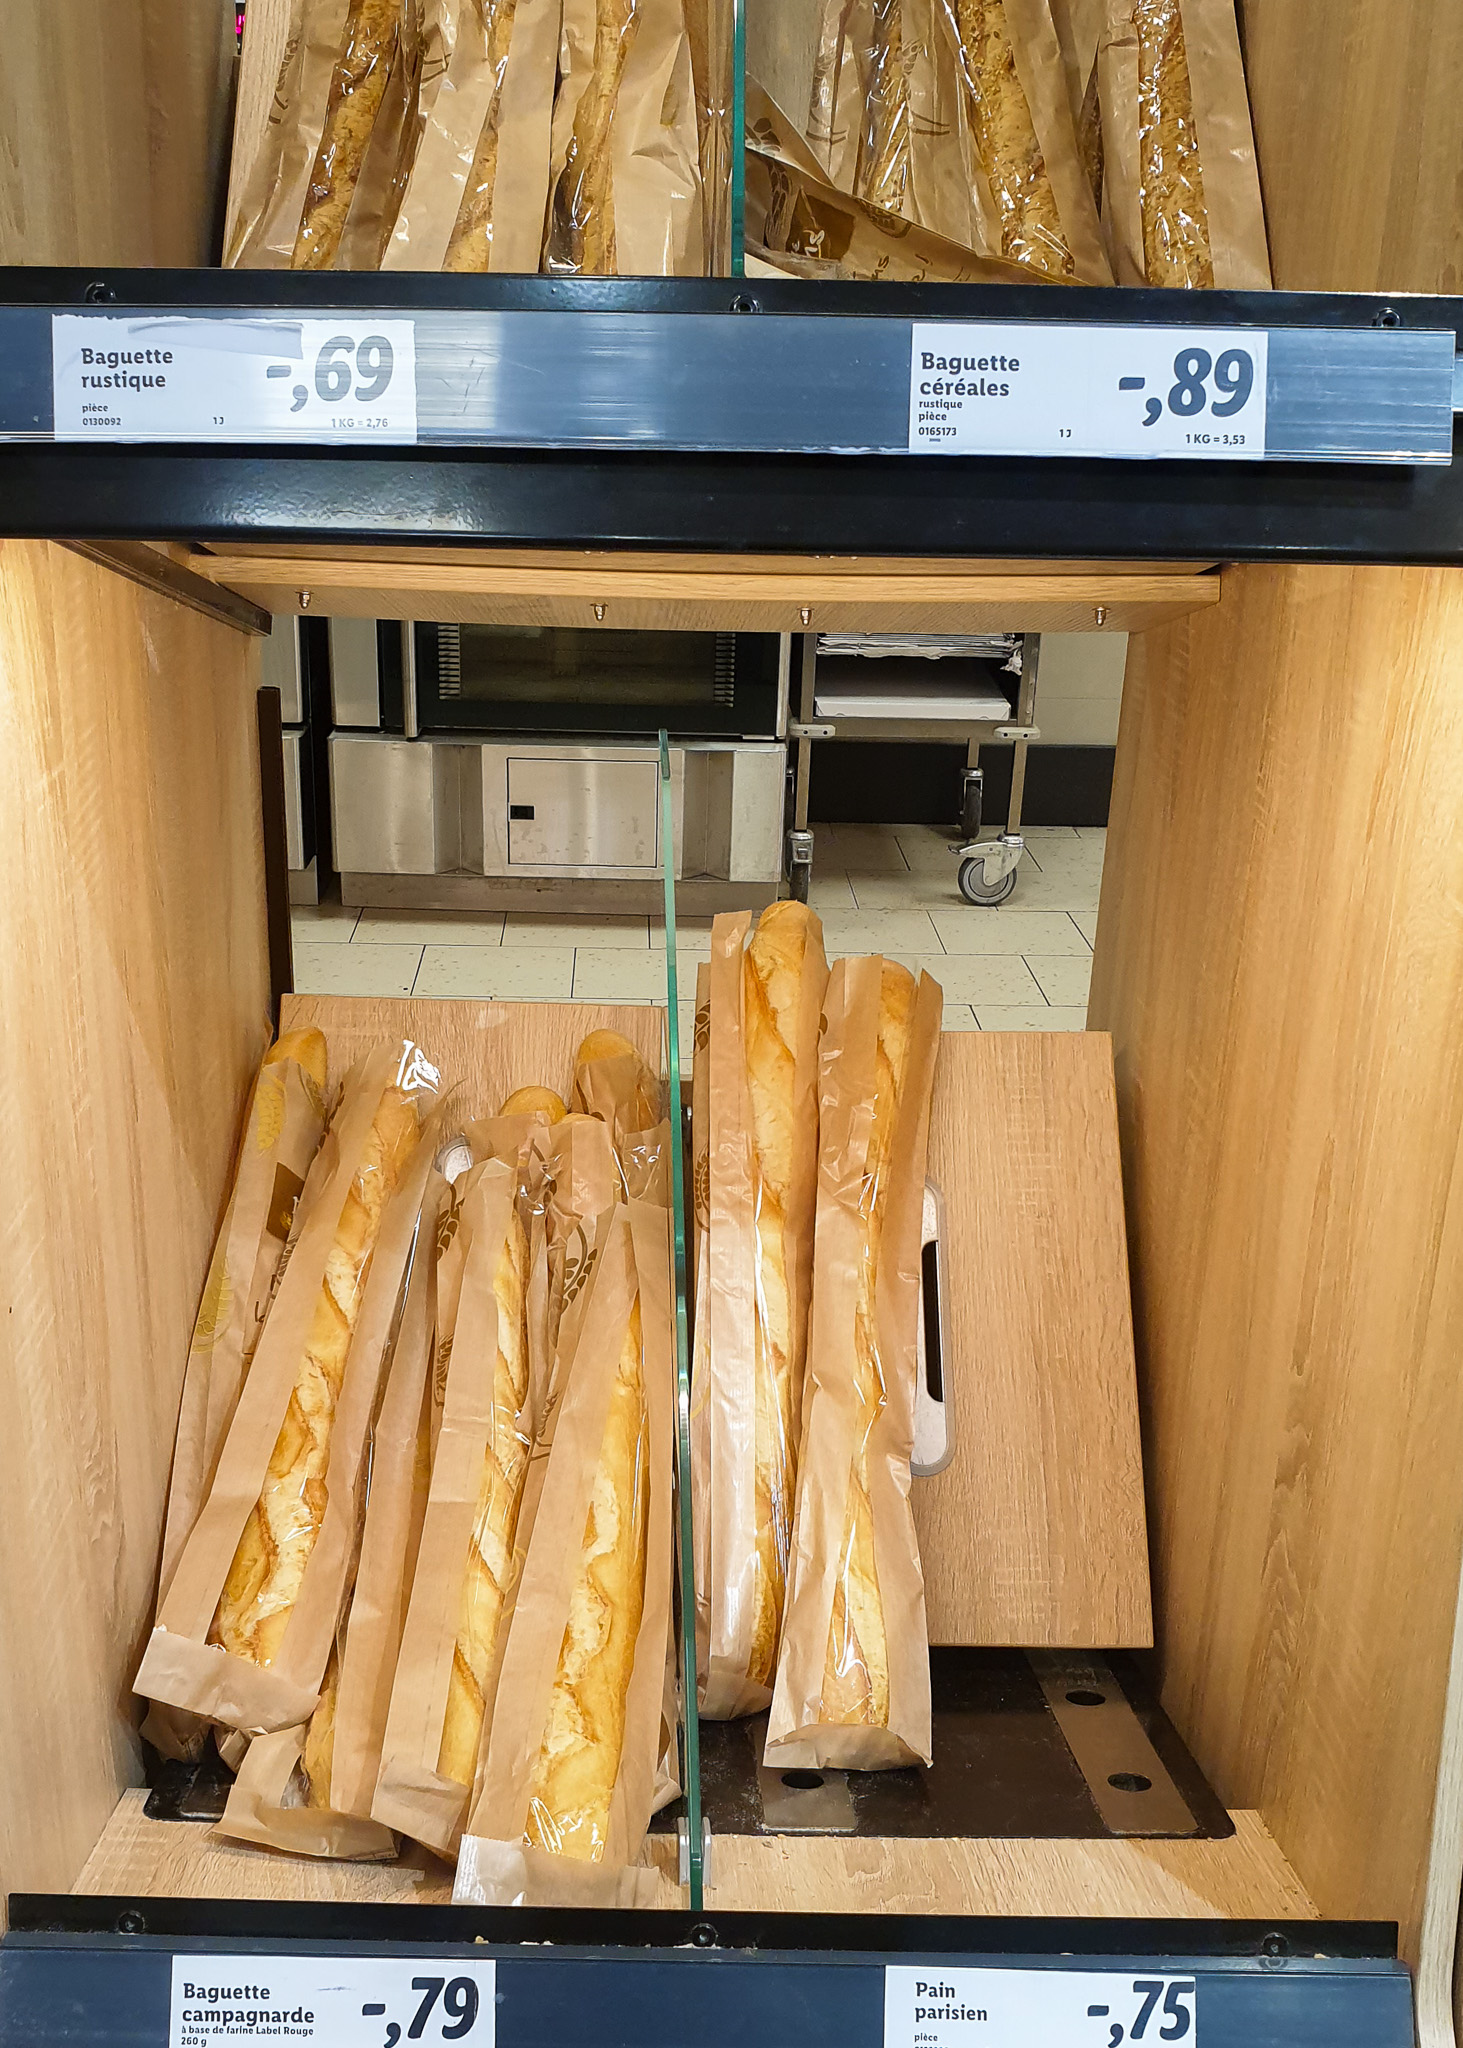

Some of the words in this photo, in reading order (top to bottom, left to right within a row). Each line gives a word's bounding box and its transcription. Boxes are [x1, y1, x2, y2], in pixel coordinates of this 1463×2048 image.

[81, 348, 173, 369] Baguette
[921, 352, 1020, 375] Baguette
[81, 370, 166, 392] rustique
[266, 335, 394, 413] -,69
[920, 378, 1010, 396] céréales
[1118, 347, 1254, 427] -,89
[82, 403, 109, 413] pièce
[919, 400, 963, 410] rustique
[82, 417, 121, 426] 0130092
[339, 418, 355, 428] KG
[366, 418, 389, 429] 2,76
[918, 411, 947, 423] pièce
[918, 427, 957, 436] 0165173
[1194, 434, 1211, 444] KG
[1222, 435, 1246, 446] 3,53
[183, 1983, 271, 2003] Baguette
[915, 1981, 955, 1998] Pain
[182, 2006, 315, 2026] campagnarde
[915, 2003, 988, 2022] parisien
[188, 2026, 210, 2034] base
[212, 2026, 224, 2034] de
[226, 2026, 254, 2035] farine
[256, 2026, 281, 2035] Label
[283, 2026, 314, 2037] Rouge
[181, 2037, 199, 2045] 260
[200, 2039, 207, 2047] g
